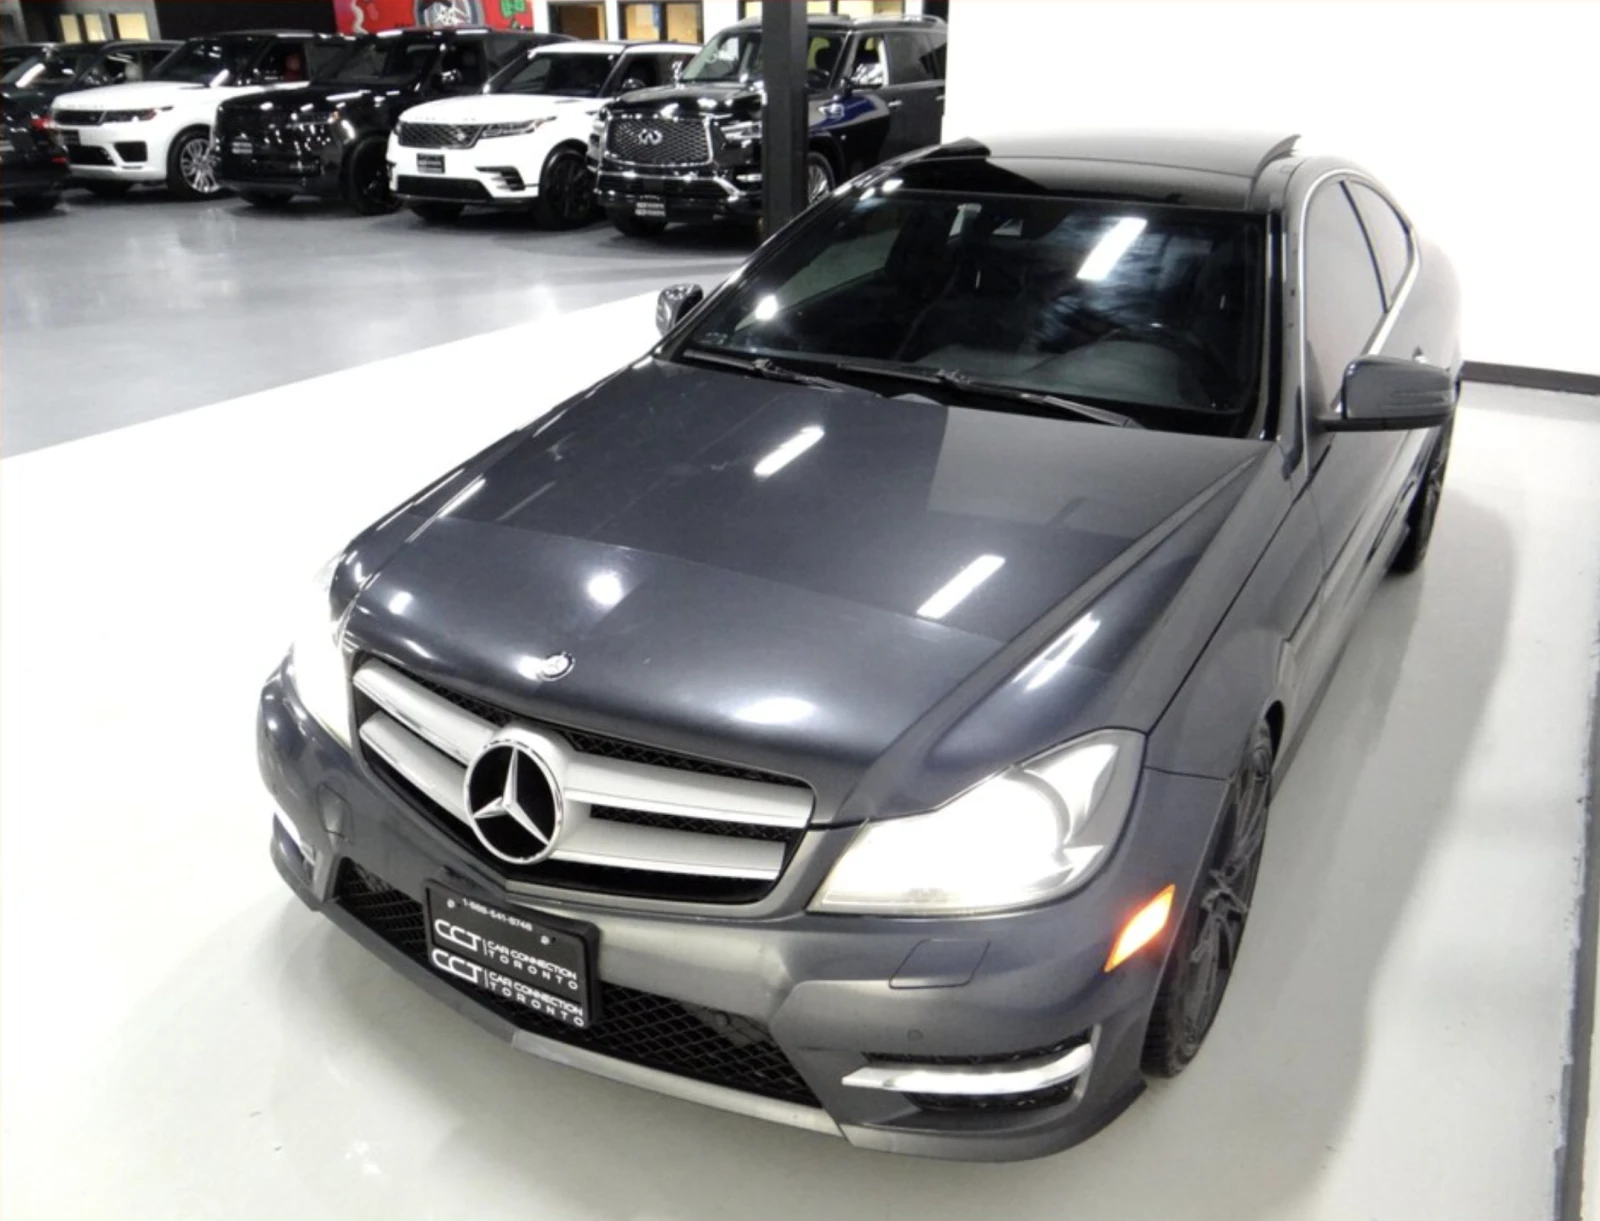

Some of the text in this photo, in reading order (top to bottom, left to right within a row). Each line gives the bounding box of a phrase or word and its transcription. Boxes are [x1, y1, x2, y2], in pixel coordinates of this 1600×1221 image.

[487, 940, 577, 980] CAR CONNECTION
[489, 951, 579, 991] TORONTO
[489, 972, 584, 1016] CAR CONNECTION
[490, 983, 584, 1027] TORONTO
